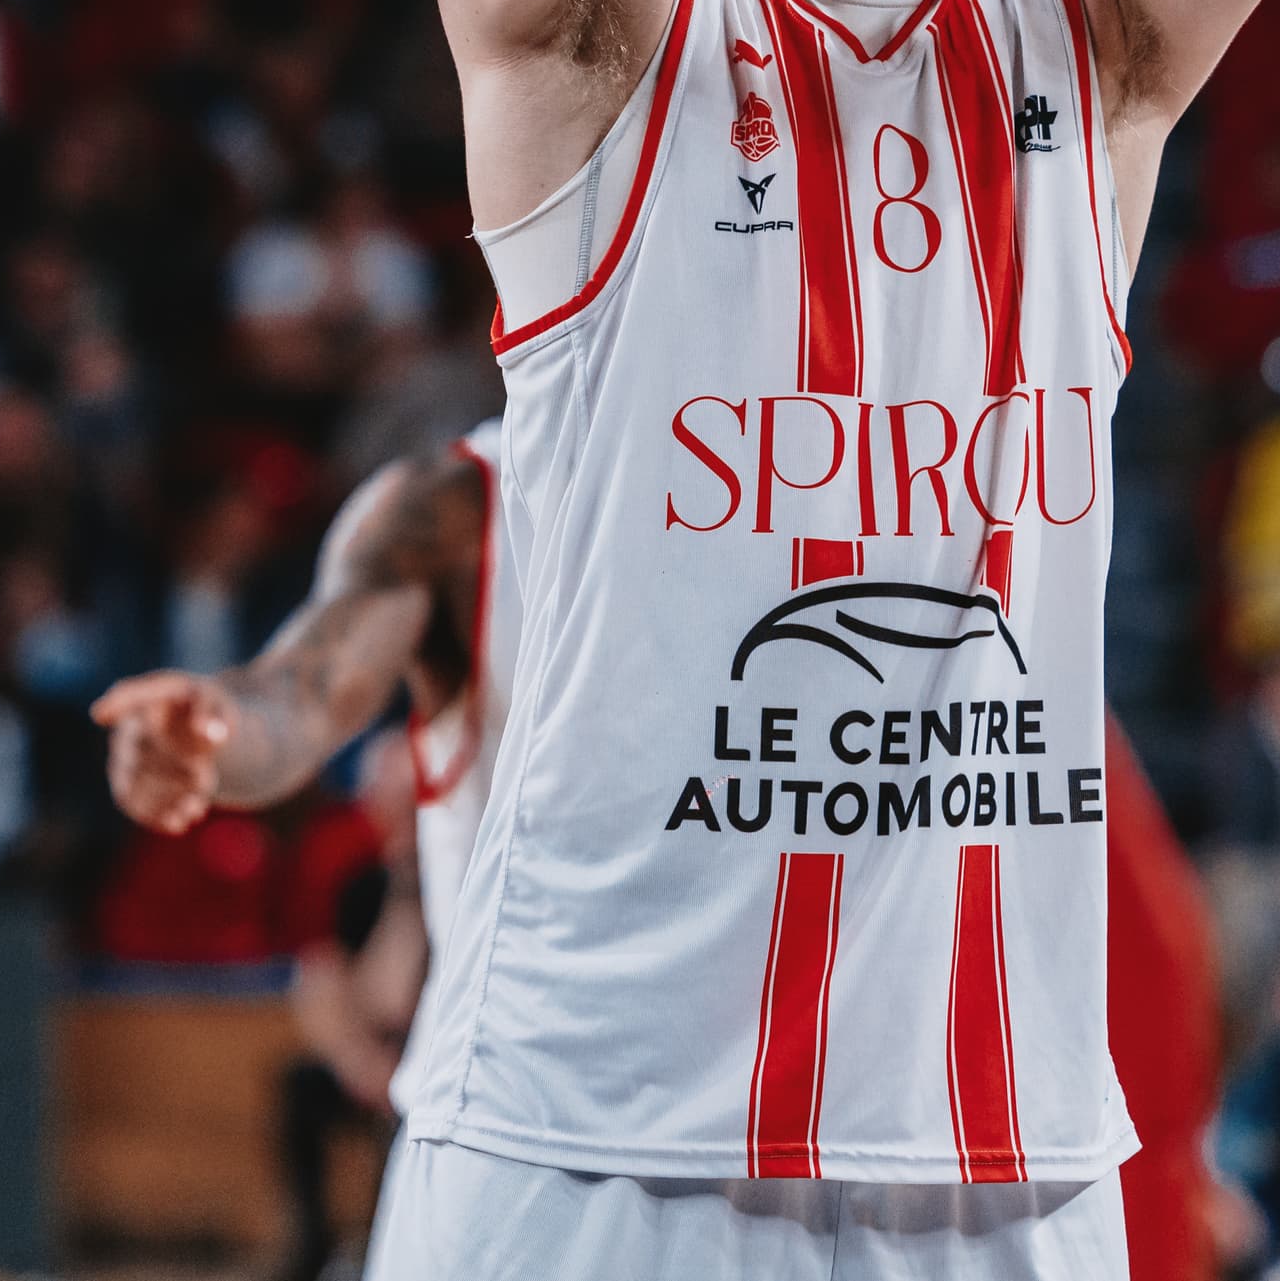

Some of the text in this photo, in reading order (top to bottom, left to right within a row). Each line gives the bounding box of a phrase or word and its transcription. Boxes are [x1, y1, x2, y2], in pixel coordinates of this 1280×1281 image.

[714, 220, 794, 235] CUPRA
[872, 123, 943, 273] 8
[665, 386, 1097, 538] SPIROU
[713, 699, 1047, 766] LE CENTRE
[664, 767, 1104, 837] AUTOMOBILE
